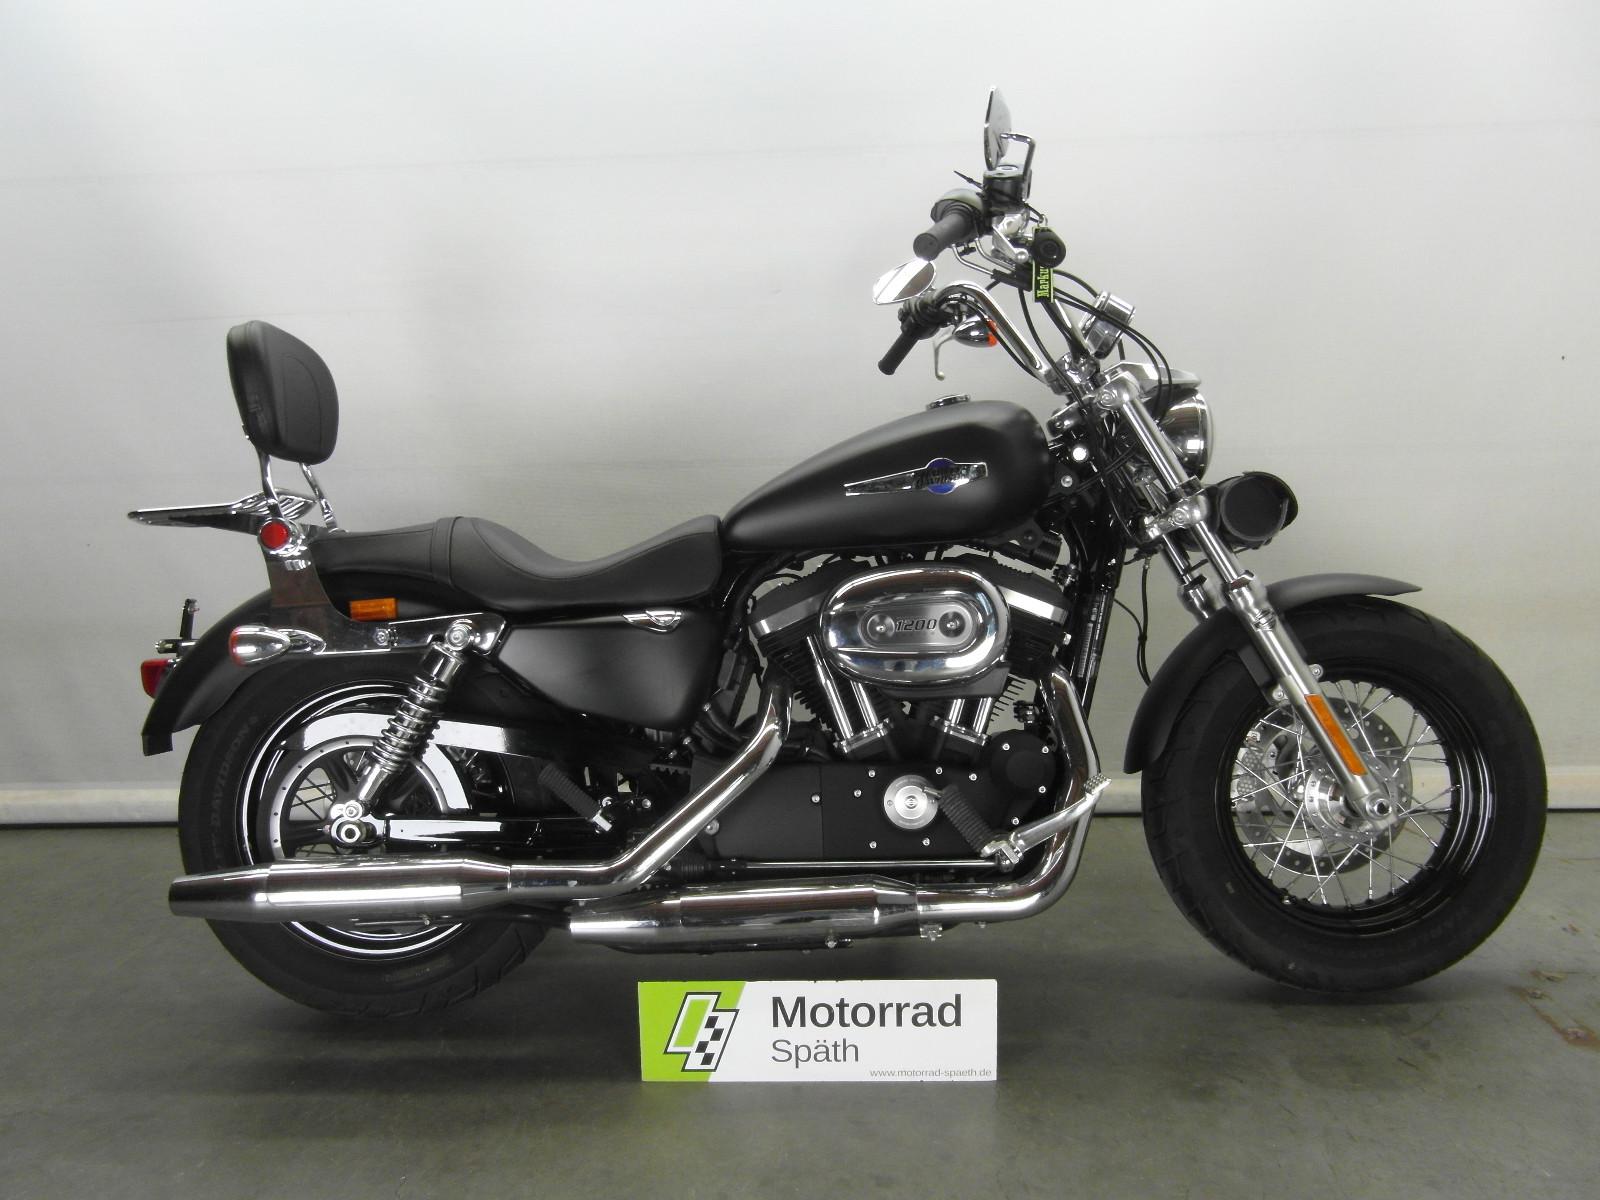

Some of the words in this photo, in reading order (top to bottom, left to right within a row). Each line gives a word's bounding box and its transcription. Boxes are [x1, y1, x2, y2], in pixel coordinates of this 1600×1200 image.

[1036, 266, 1049, 297] Marku
[896, 618, 937, 632] 1200
[772, 994, 962, 1028] Motorrad
[771, 1038, 859, 1069] Späth
[870, 1068, 992, 1078] www.motorrad-spaeth.de
